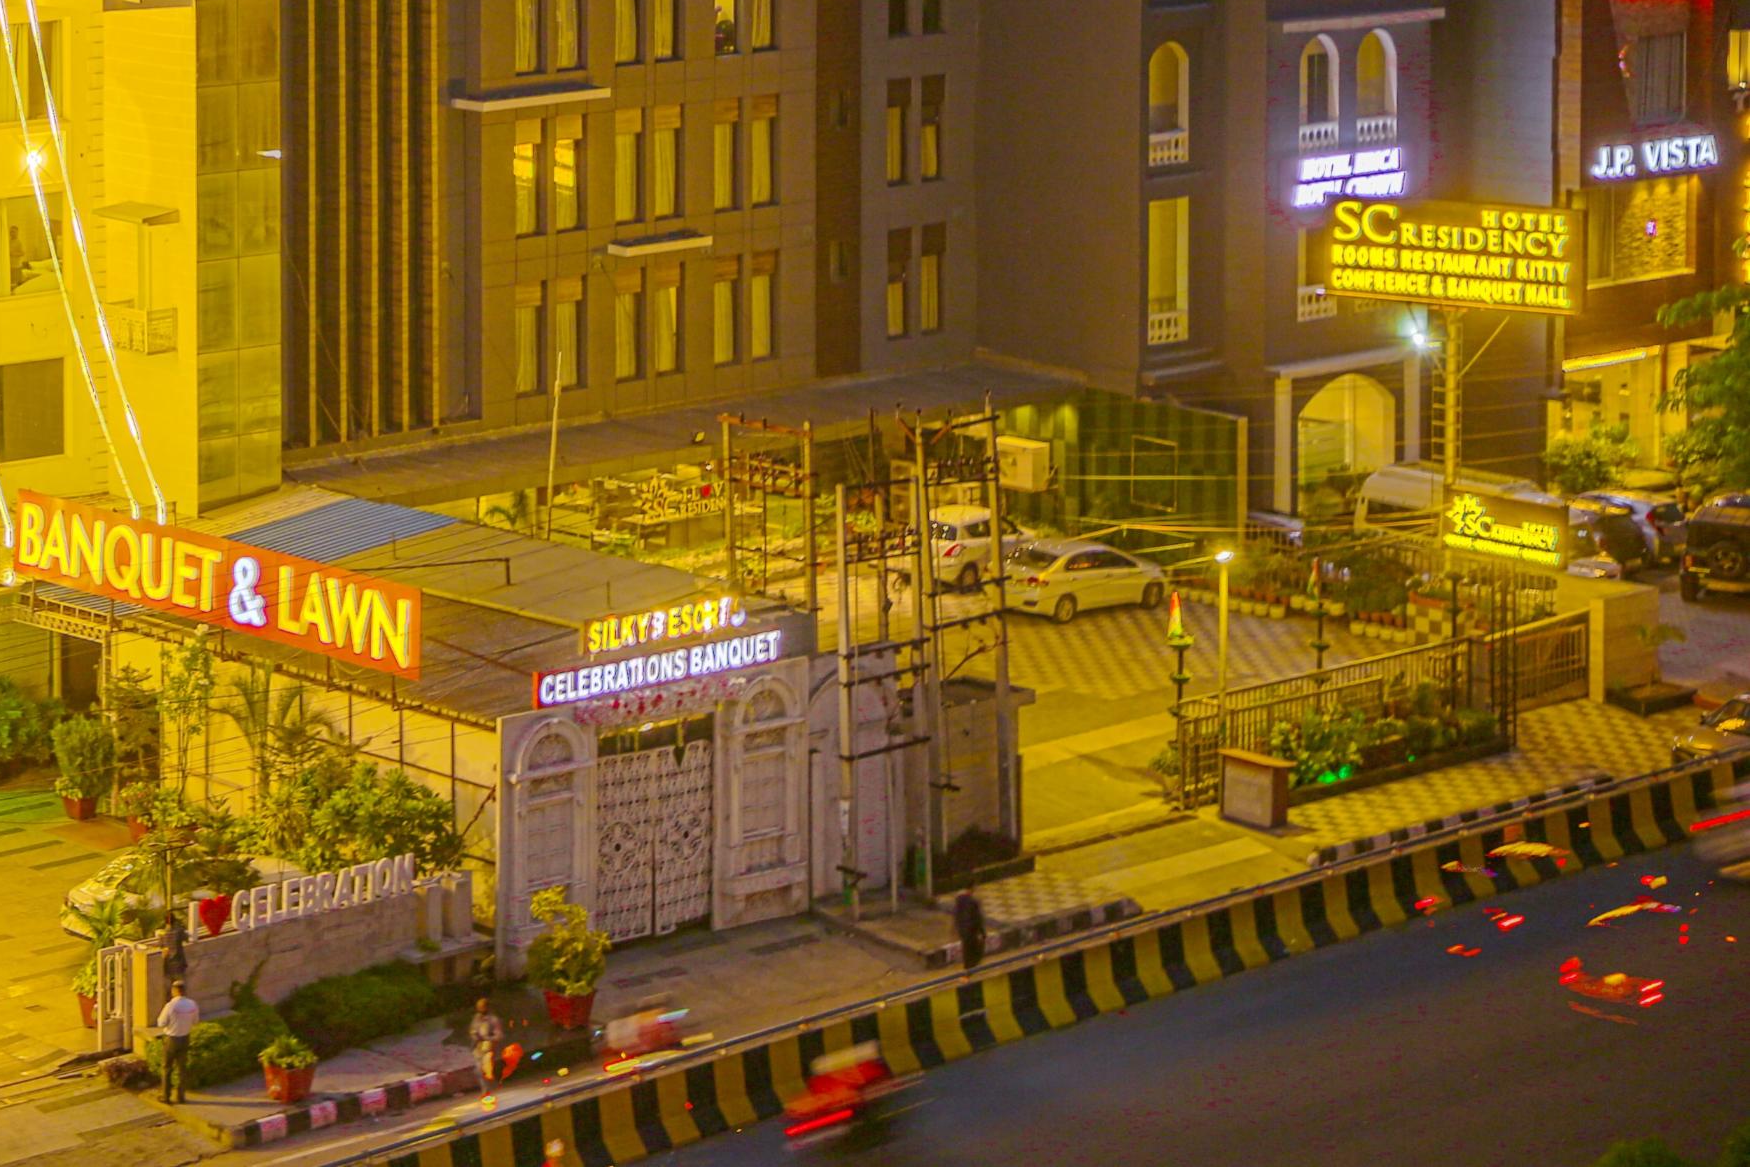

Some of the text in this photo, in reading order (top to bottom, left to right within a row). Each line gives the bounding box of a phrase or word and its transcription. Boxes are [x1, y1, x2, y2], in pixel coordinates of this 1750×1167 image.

[1591, 135, 1718, 178] J.P. VISTA
[1333, 201, 1569, 257] SC RESIDENCY
[1481, 210, 1568, 233] HOTEL
[1331, 244, 1570, 283] ROOMS RESTAURANT KITTY
[1331, 268, 1571, 308] CONFRENCE & BANQUET HALL
[18, 502, 412, 670] BANQUET & LAWN
[587, 612, 650, 653] SILKY
[540, 629, 782, 706] CELEBRATIONS BANQUET
[231, 852, 415, 931] CELEBRATION
